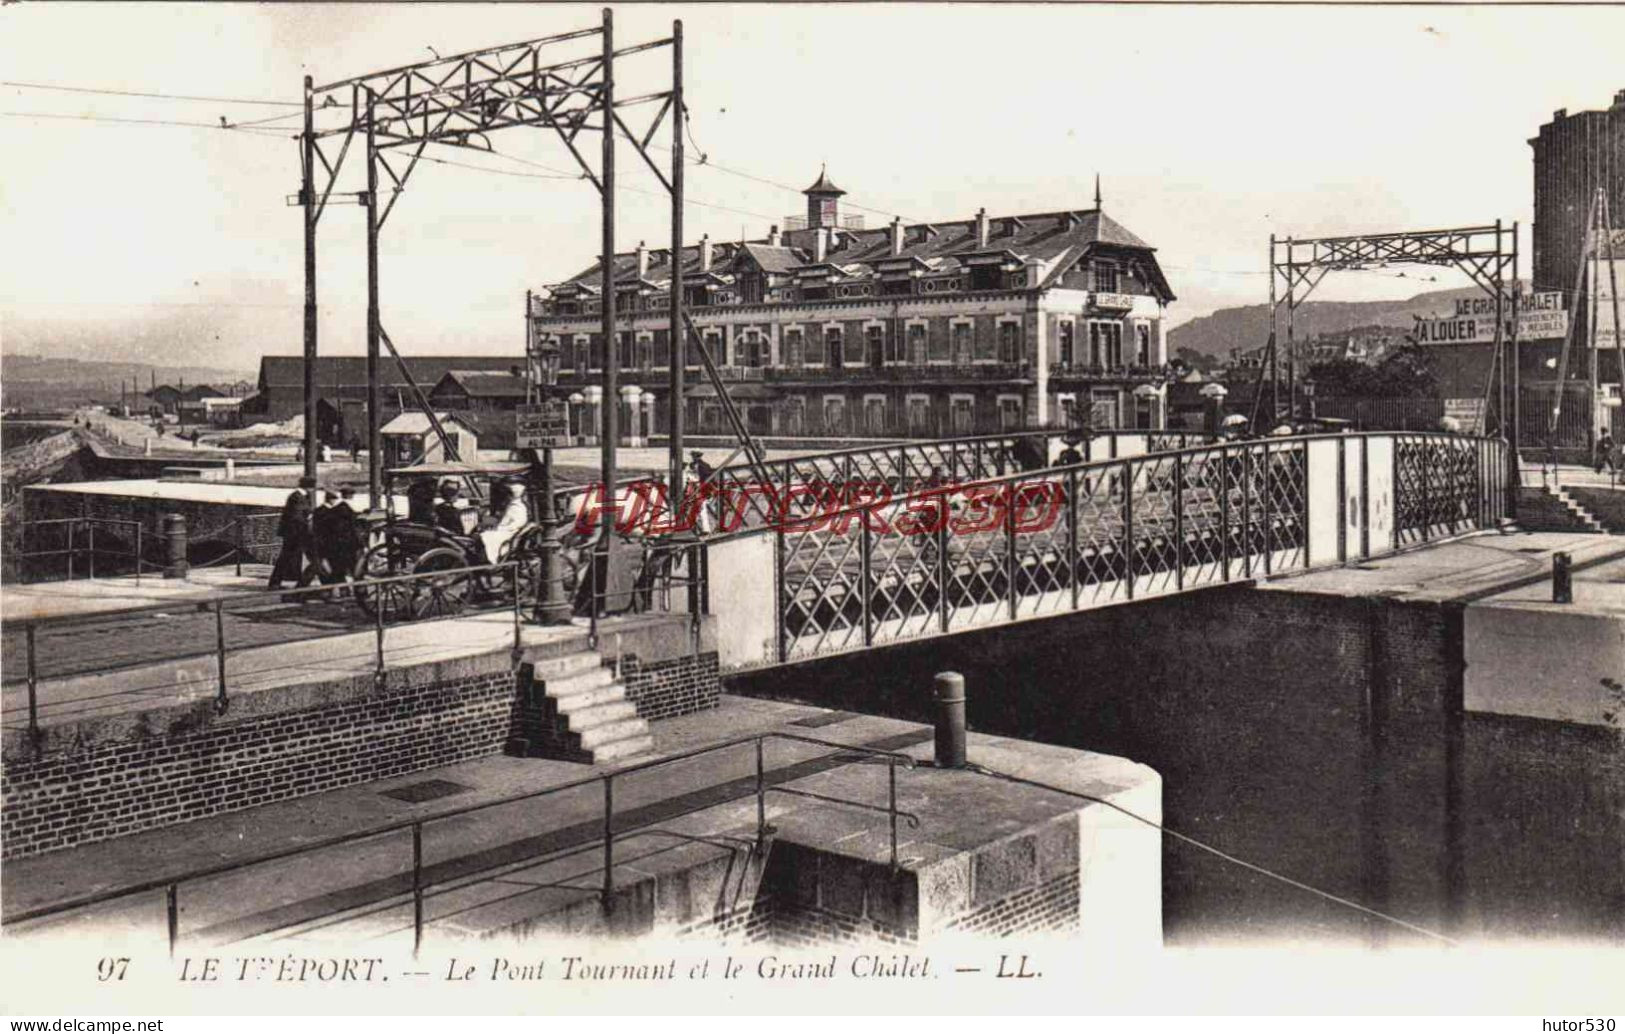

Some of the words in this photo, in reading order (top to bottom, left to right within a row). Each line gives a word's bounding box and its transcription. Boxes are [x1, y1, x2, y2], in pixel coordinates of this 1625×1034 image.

[1456, 299, 1470, 315] LE
[1473, 296, 1510, 314] GRAD
[1420, 321, 1429, 342] A
[1431, 320, 1477, 341] LOUER
